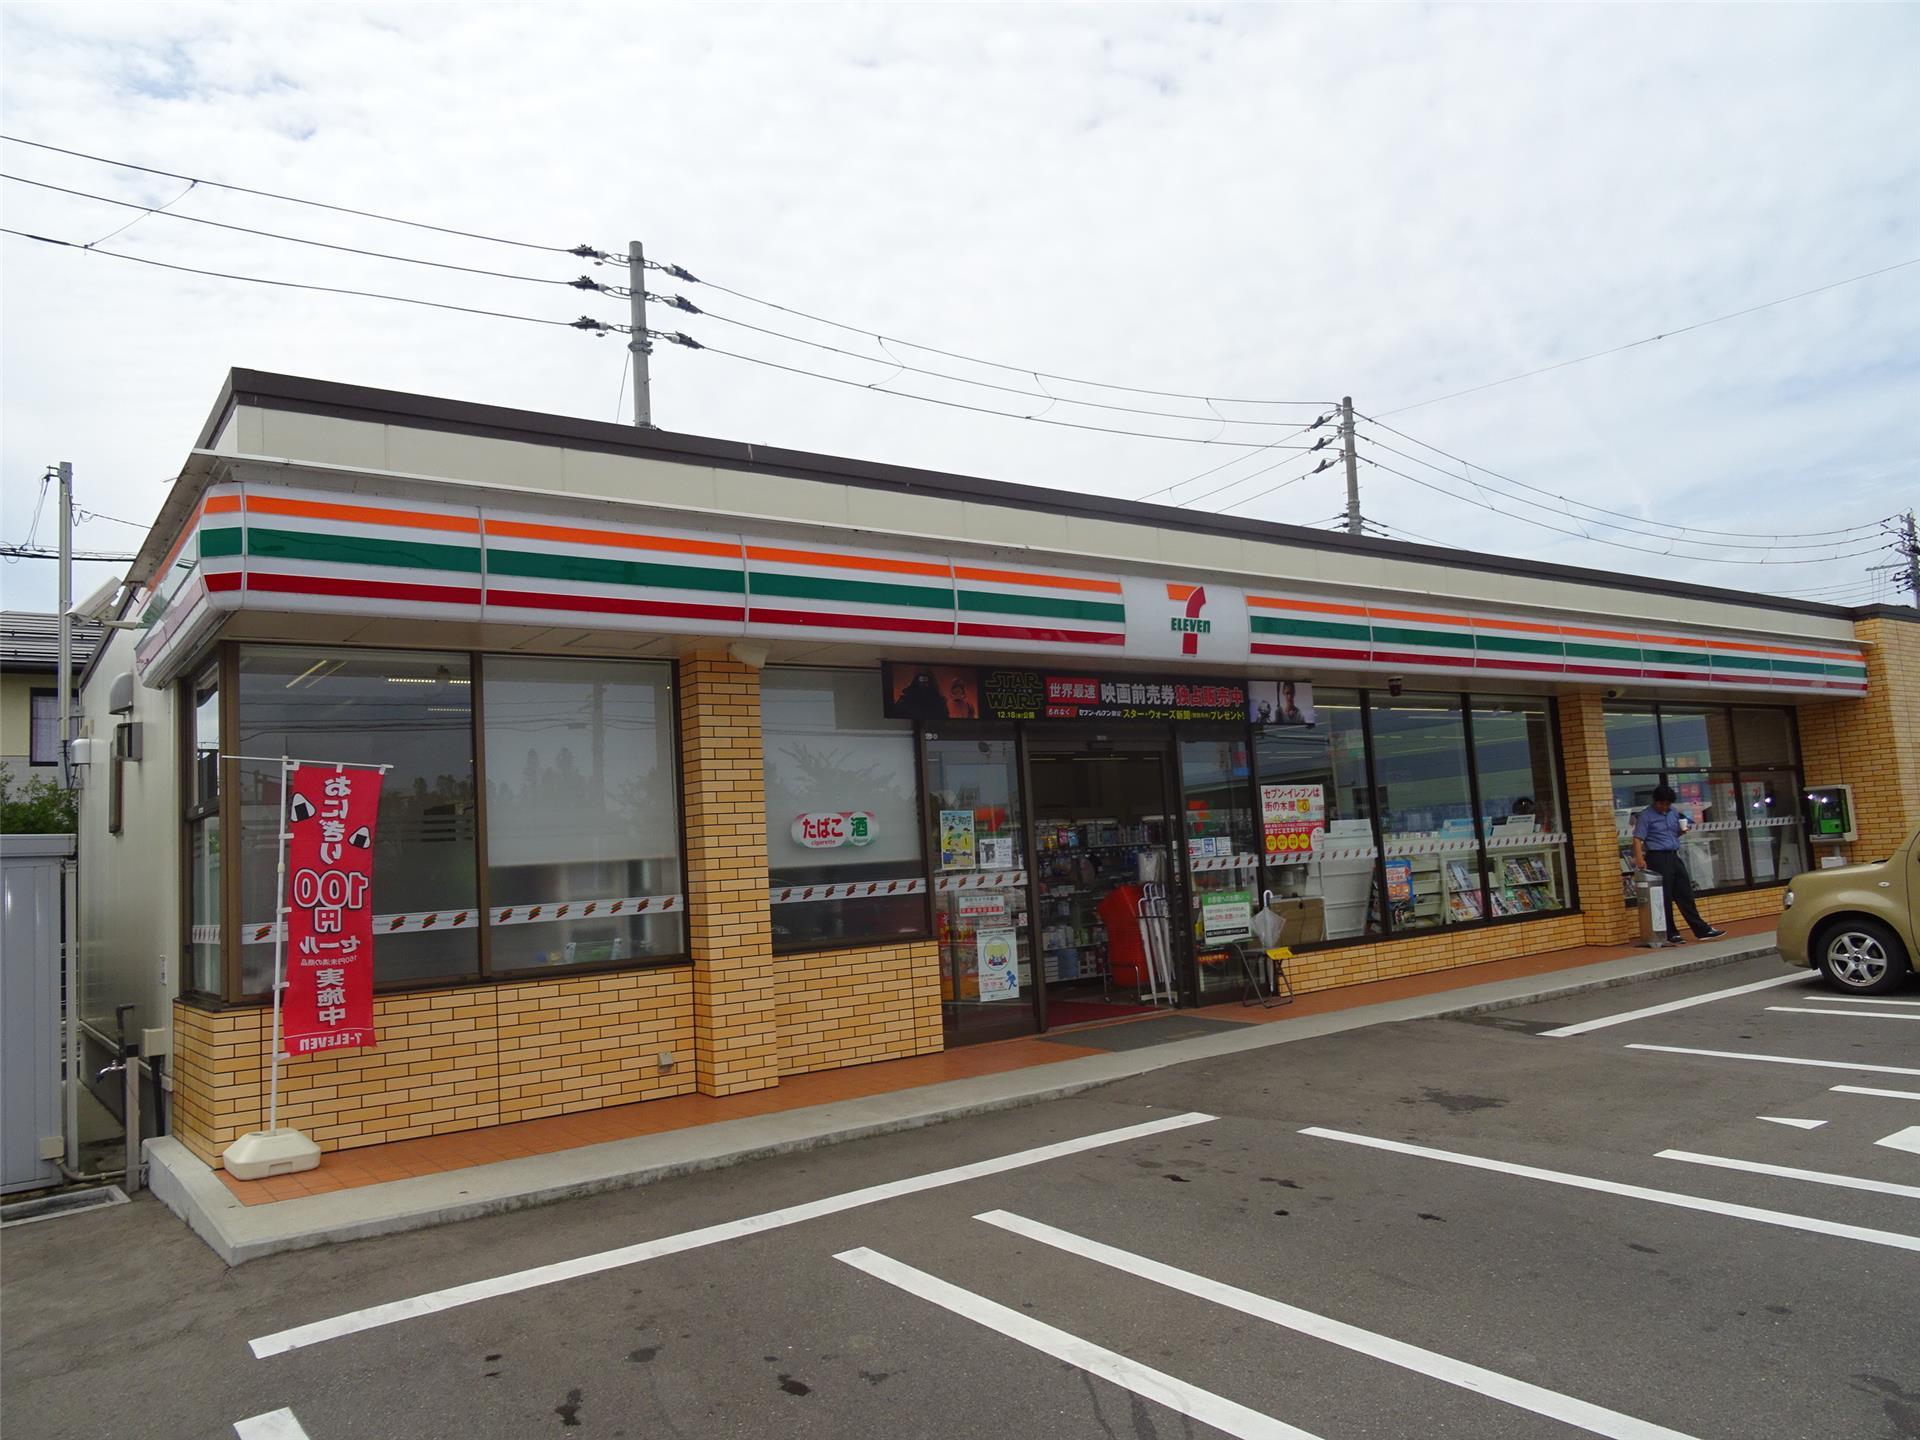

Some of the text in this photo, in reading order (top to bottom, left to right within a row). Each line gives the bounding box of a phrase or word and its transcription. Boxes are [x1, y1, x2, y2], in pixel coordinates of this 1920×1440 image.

[985, 671, 1043, 689] STAR
[1050, 683, 1096, 699] 世界最速
[985, 692, 1043, 710] WARS
[803, 817, 868, 838] たばこ 酒
